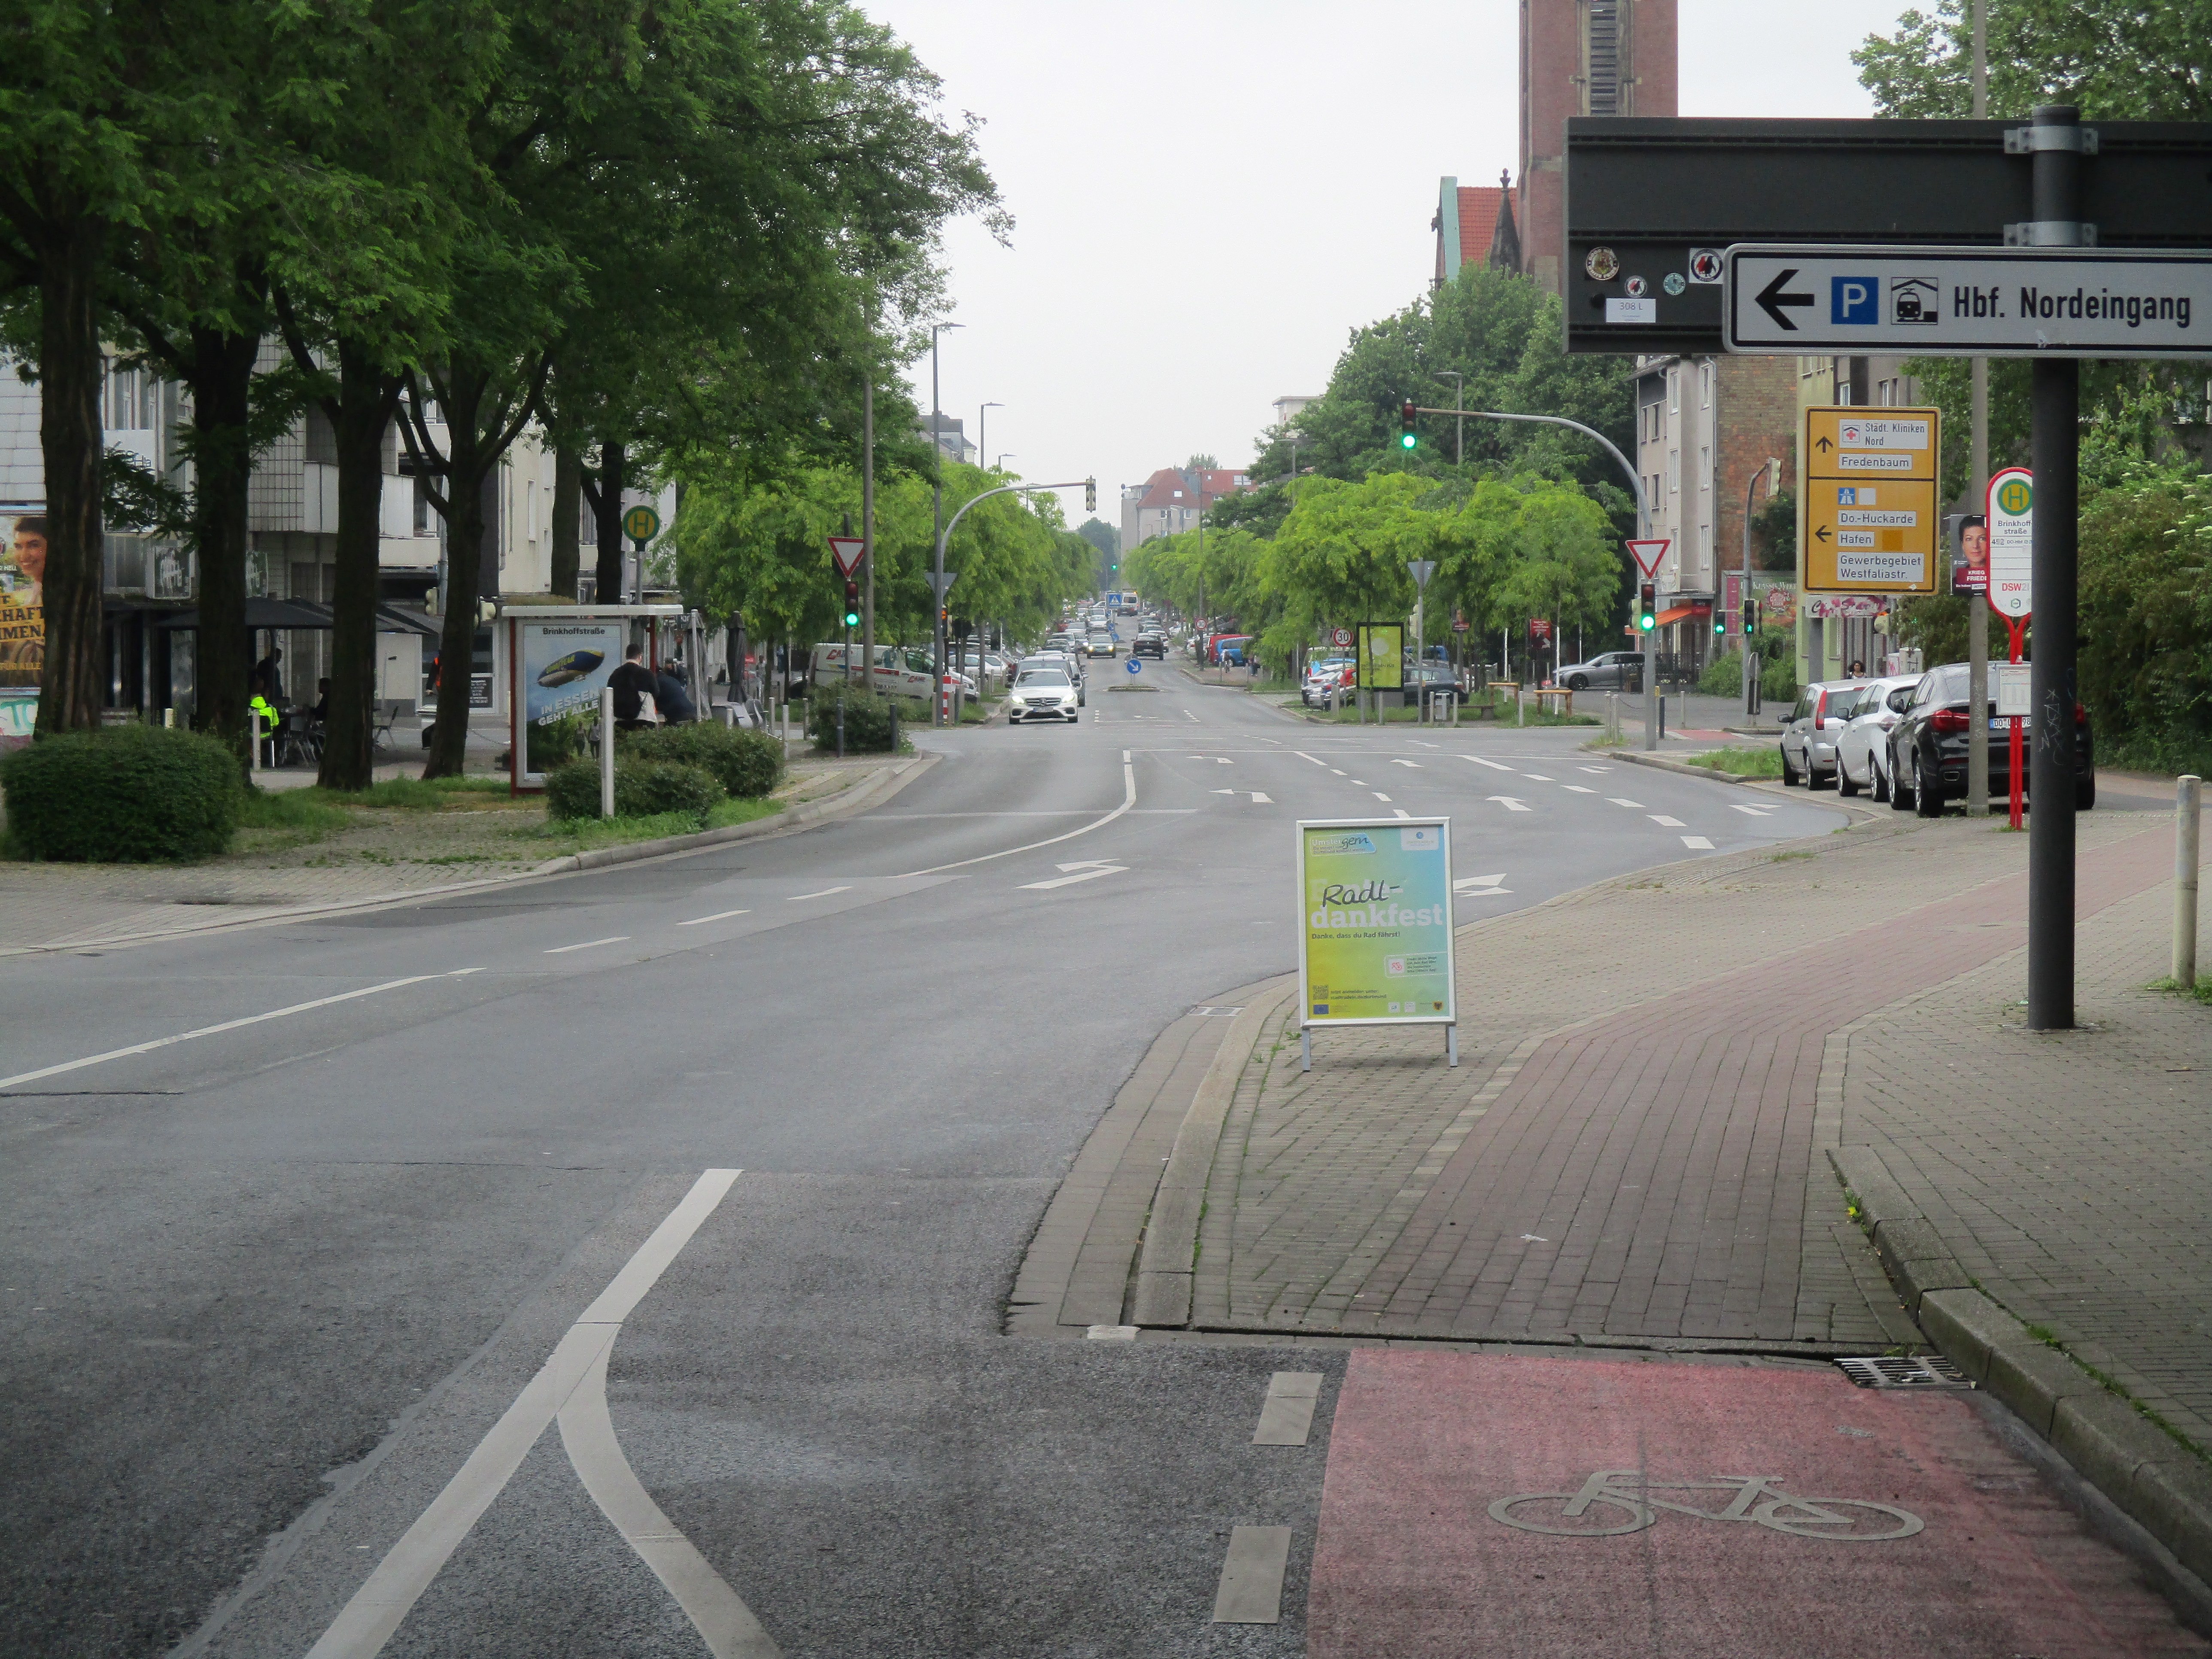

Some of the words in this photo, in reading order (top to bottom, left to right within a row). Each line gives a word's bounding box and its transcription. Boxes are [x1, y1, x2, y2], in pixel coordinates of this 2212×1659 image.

[1620, 302, 1636, 310] 308
[1954, 286, 2005, 318] Hbf.
[2021, 287, 2191, 328] Nordeingang
[1865, 422, 1889, 432] Städt.
[1892, 423, 1925, 433] Kliniken
[1865, 436, 1884, 446] Nord
[1841, 456, 1909, 467] Fredenbaum
[1841, 513, 1913, 523] Do.-Huckarde
[1840, 535, 1872, 544] Hafen
[1840, 555, 1921, 567] Gewerbegebiet
[1841, 568, 1908, 579] Westfaliastr.
[1337, 632, 1349, 641] 30
[541, 704, 553, 714] IN
[538, 709, 568, 726] GEHT
[1311, 900, 1443, 928] dankfest
[1378, 930, 1401, 938] fährst!
